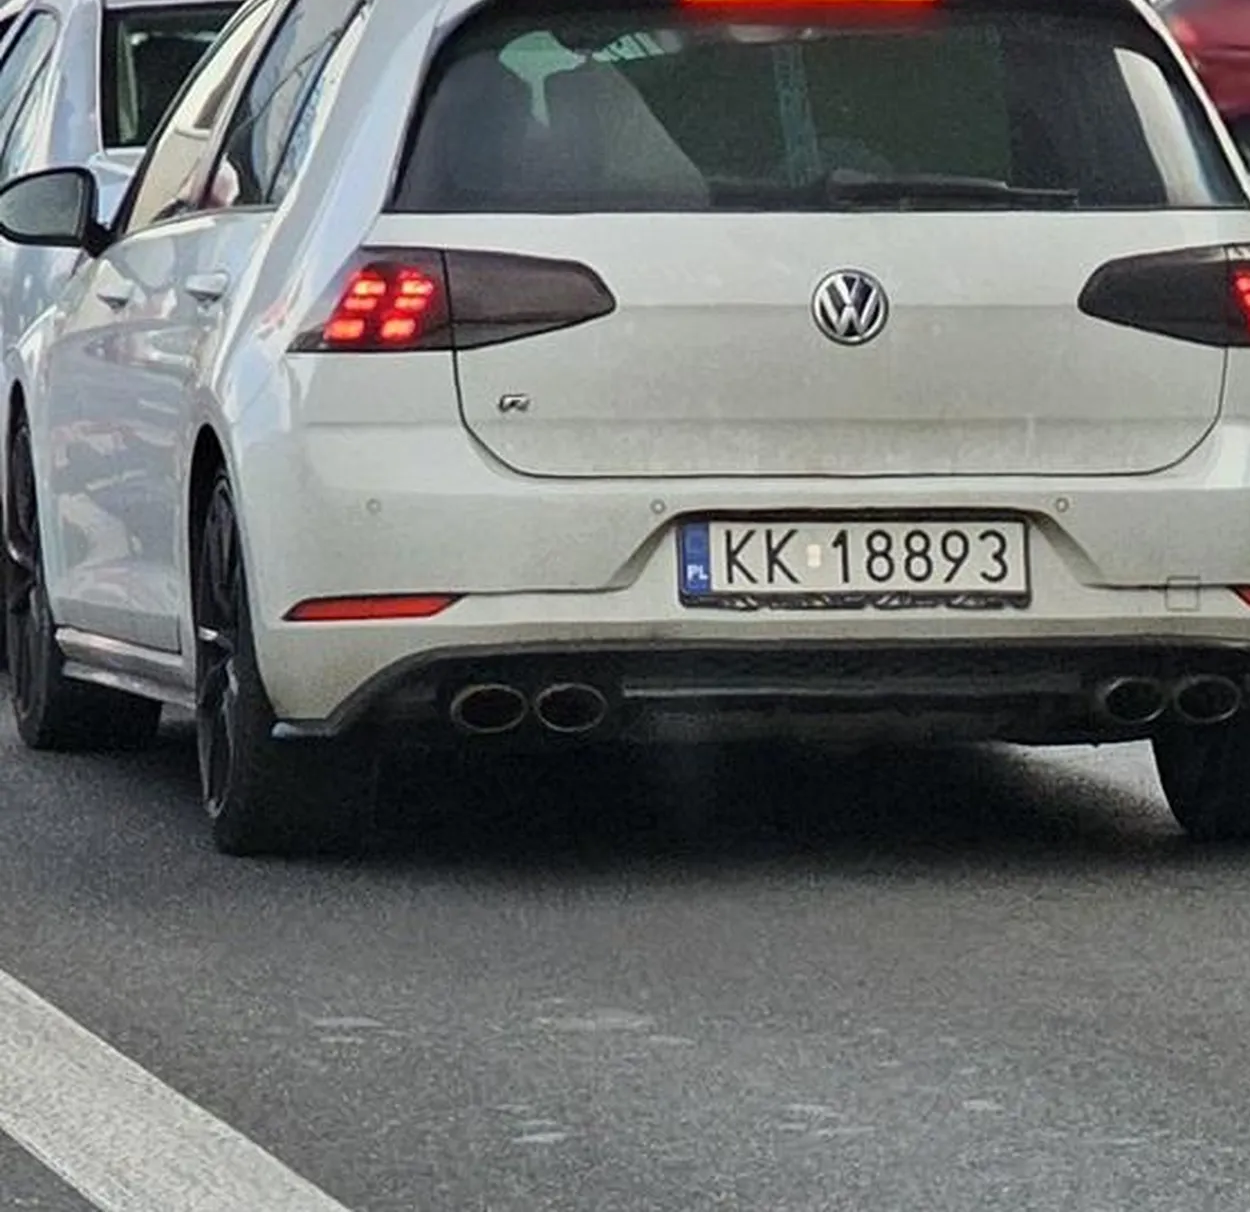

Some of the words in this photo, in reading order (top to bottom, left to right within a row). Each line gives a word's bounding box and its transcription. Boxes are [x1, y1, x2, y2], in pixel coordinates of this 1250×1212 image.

[687, 564, 708, 580] PL
[725, 528, 800, 584] KK
[832, 528, 1008, 584] 18893
